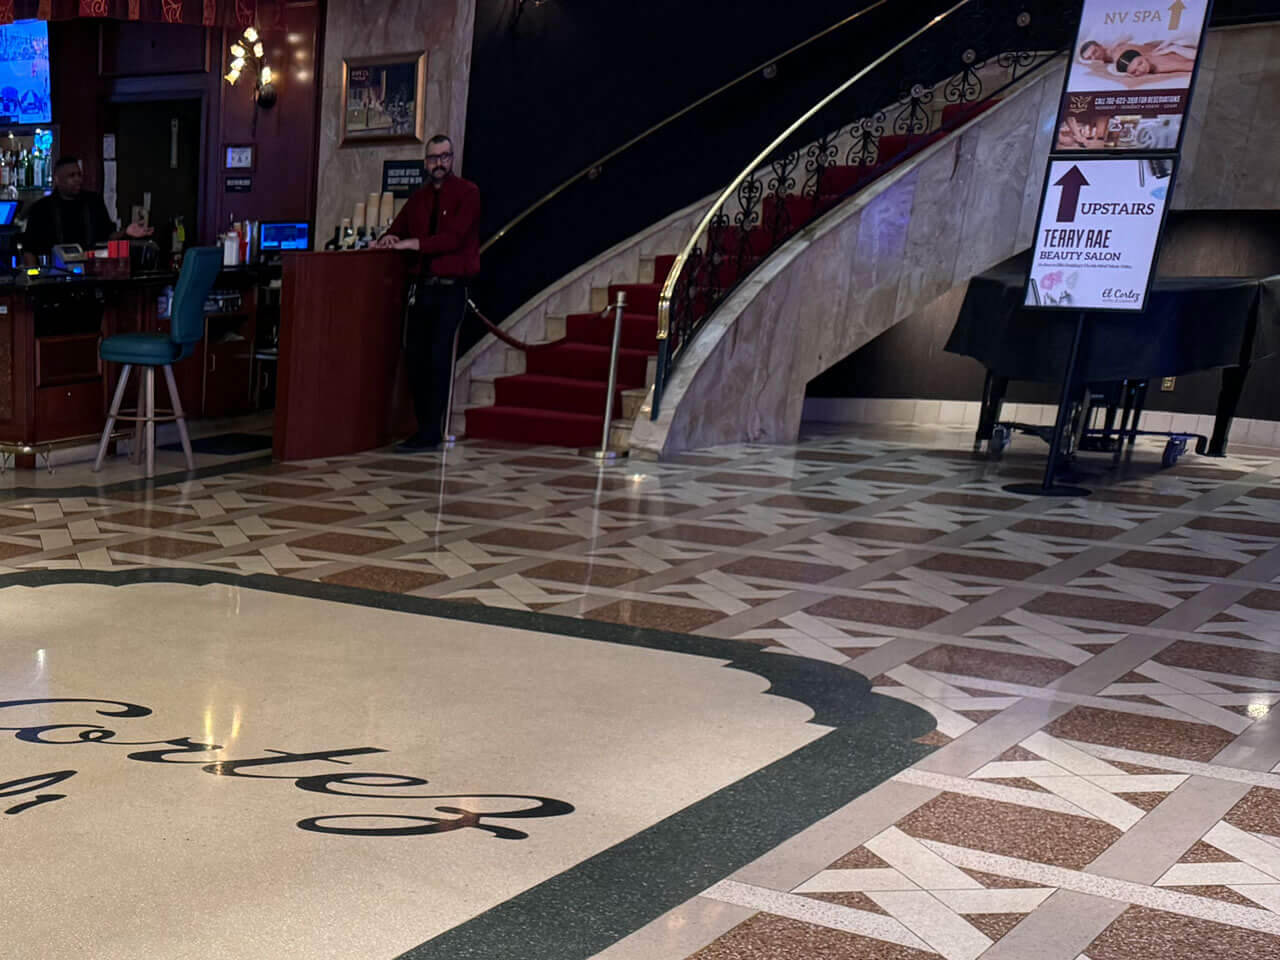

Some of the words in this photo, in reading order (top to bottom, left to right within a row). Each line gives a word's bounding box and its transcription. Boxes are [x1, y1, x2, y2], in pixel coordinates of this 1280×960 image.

[1104, 12, 1128, 24] NV
[1132, 10, 1162, 24] SPA
[1081, 202, 1156, 215] UPSTAIRS
[1043, 229, 1086, 248] TERRY
[1085, 229, 1113, 248] RAE
[1039, 251, 1083, 261] BEAUTY
[1084, 252, 1122, 262] SALON
[1102, 287, 1114, 298] El
[1114, 289, 1141, 303] Cortez
